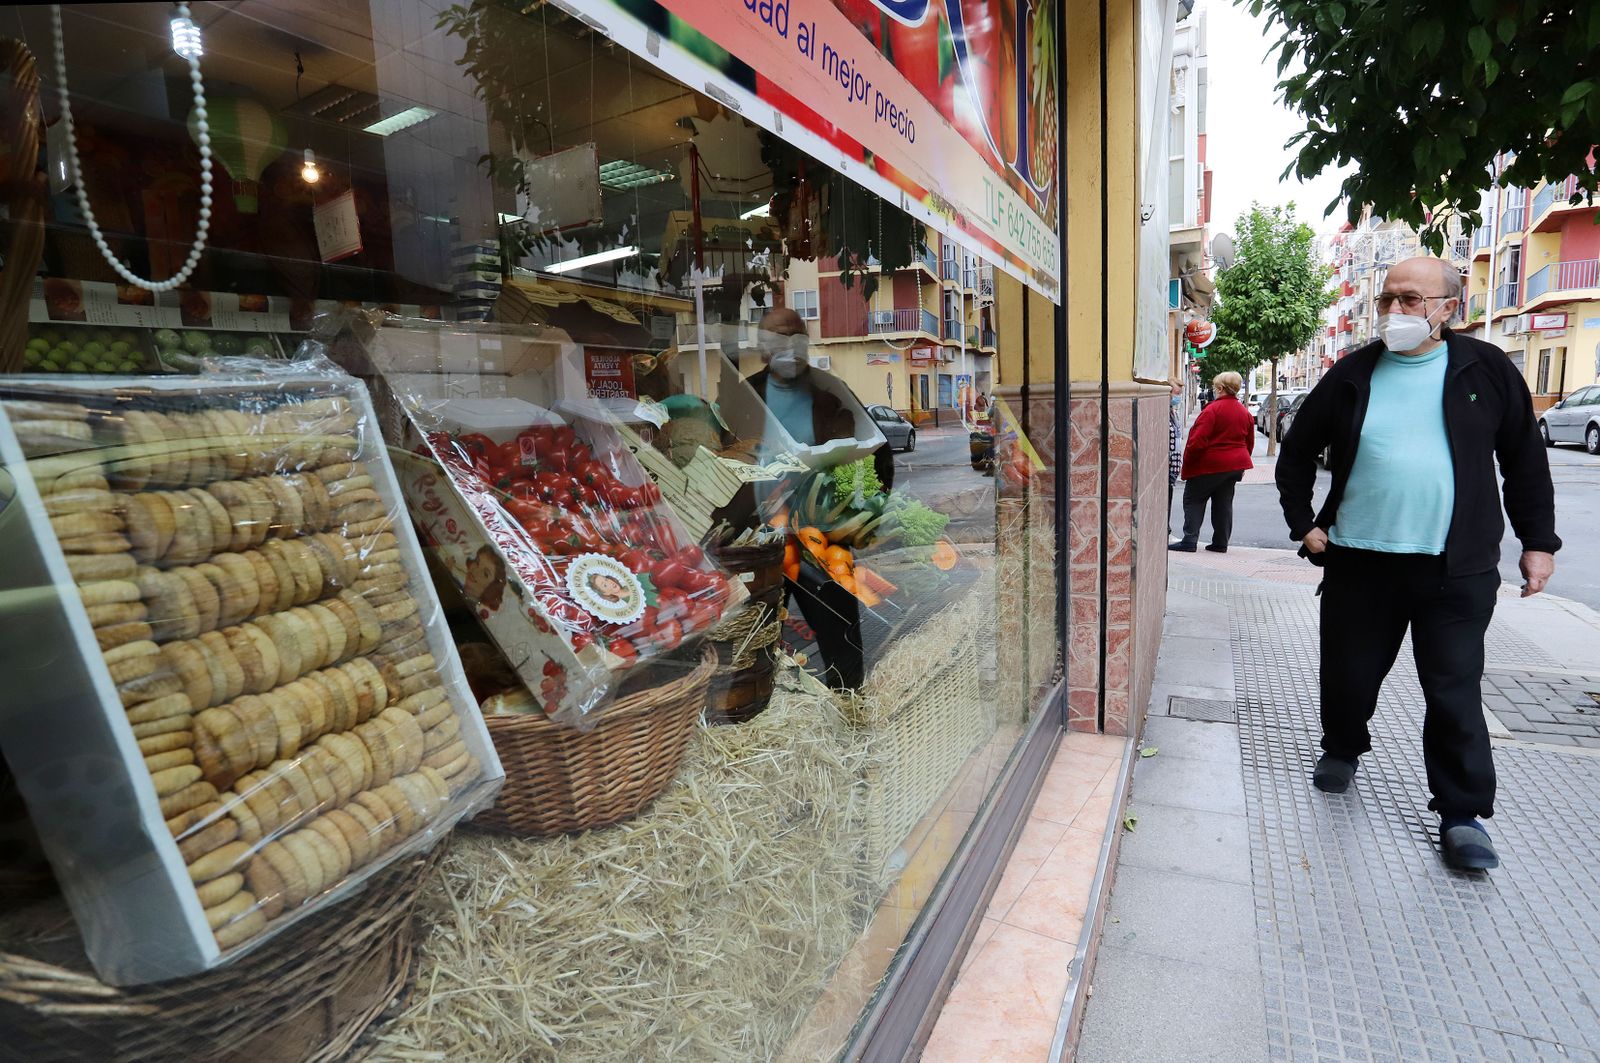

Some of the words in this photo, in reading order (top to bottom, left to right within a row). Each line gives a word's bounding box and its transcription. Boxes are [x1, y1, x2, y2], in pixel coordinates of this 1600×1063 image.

[797, 22, 816, 61] al
[822, 42, 871, 106] mejor
[875, 89, 916, 144] precio
[983, 175, 1004, 228] TLF
[1007, 201, 1025, 247] 642
[1026, 219, 1042, 260] 755
